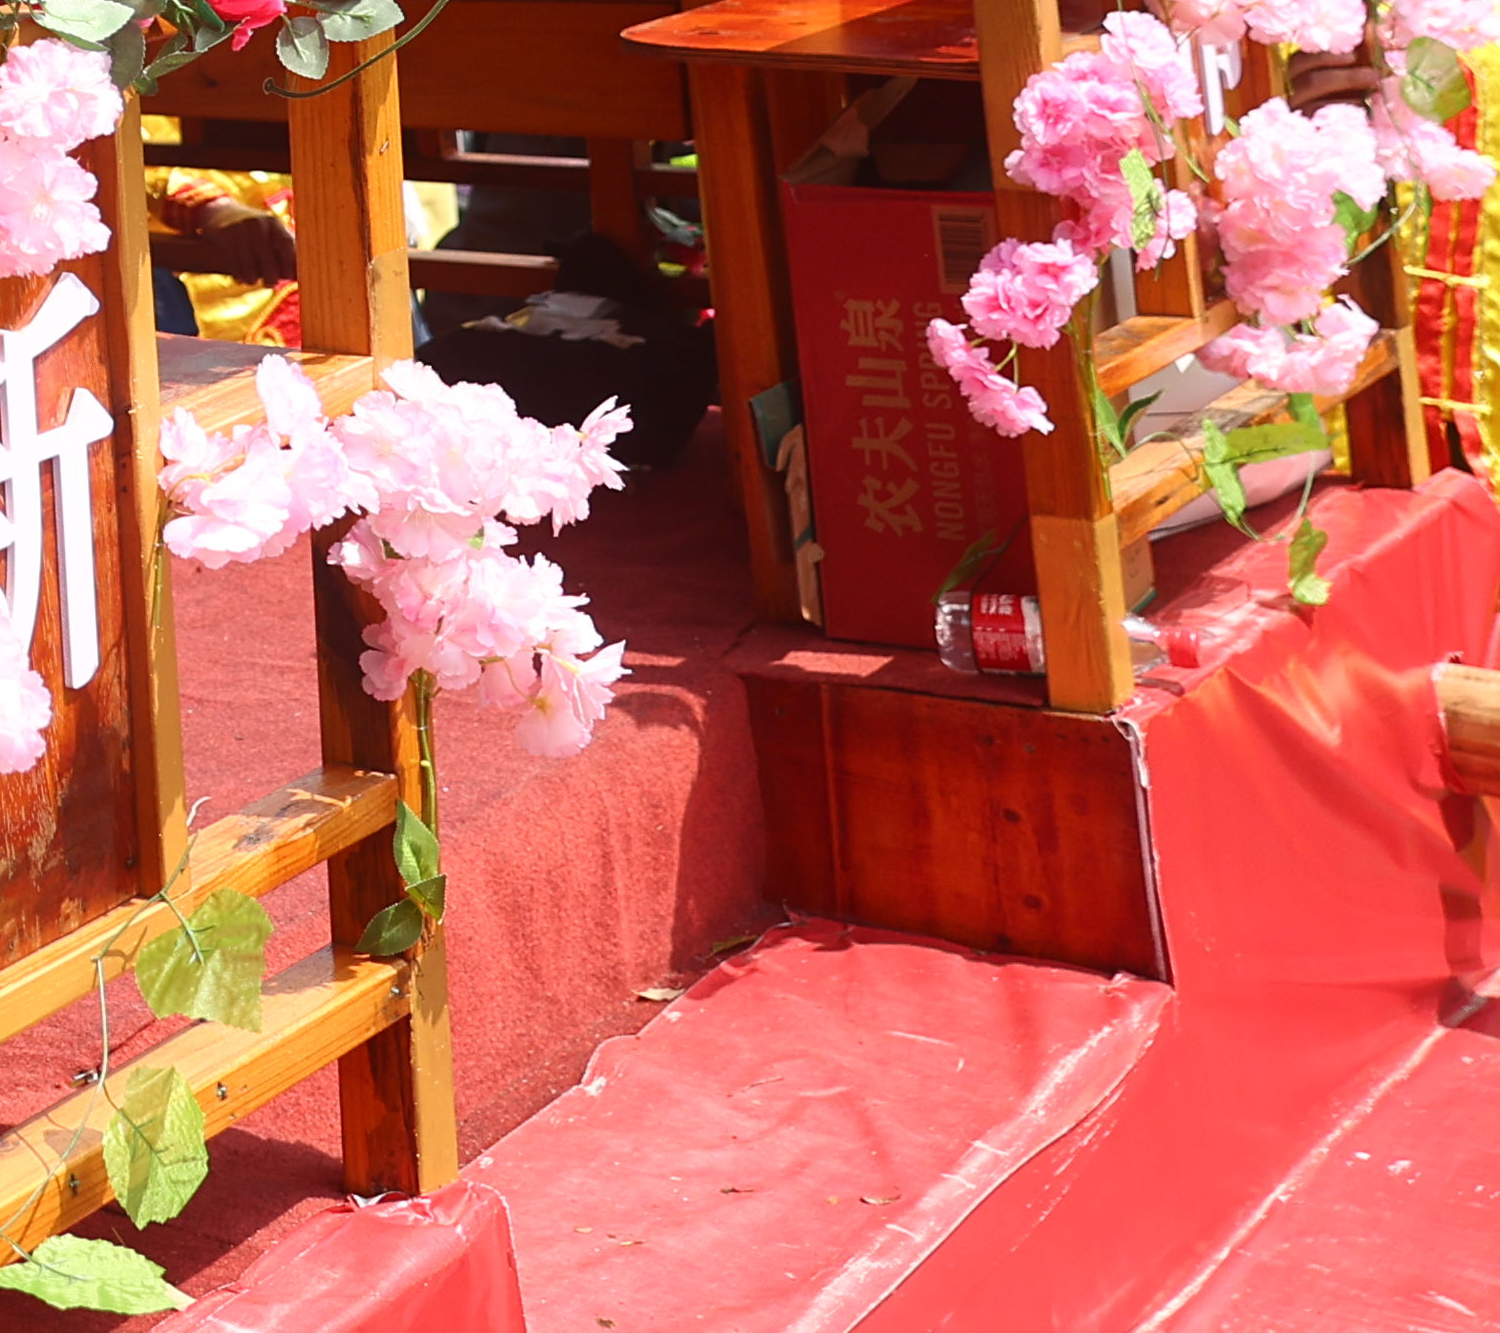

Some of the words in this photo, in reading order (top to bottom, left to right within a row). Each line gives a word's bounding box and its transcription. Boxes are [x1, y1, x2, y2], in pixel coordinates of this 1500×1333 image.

[839, 297, 925, 538] 农夫山泉
[924, 420, 966, 541] NONGFU
